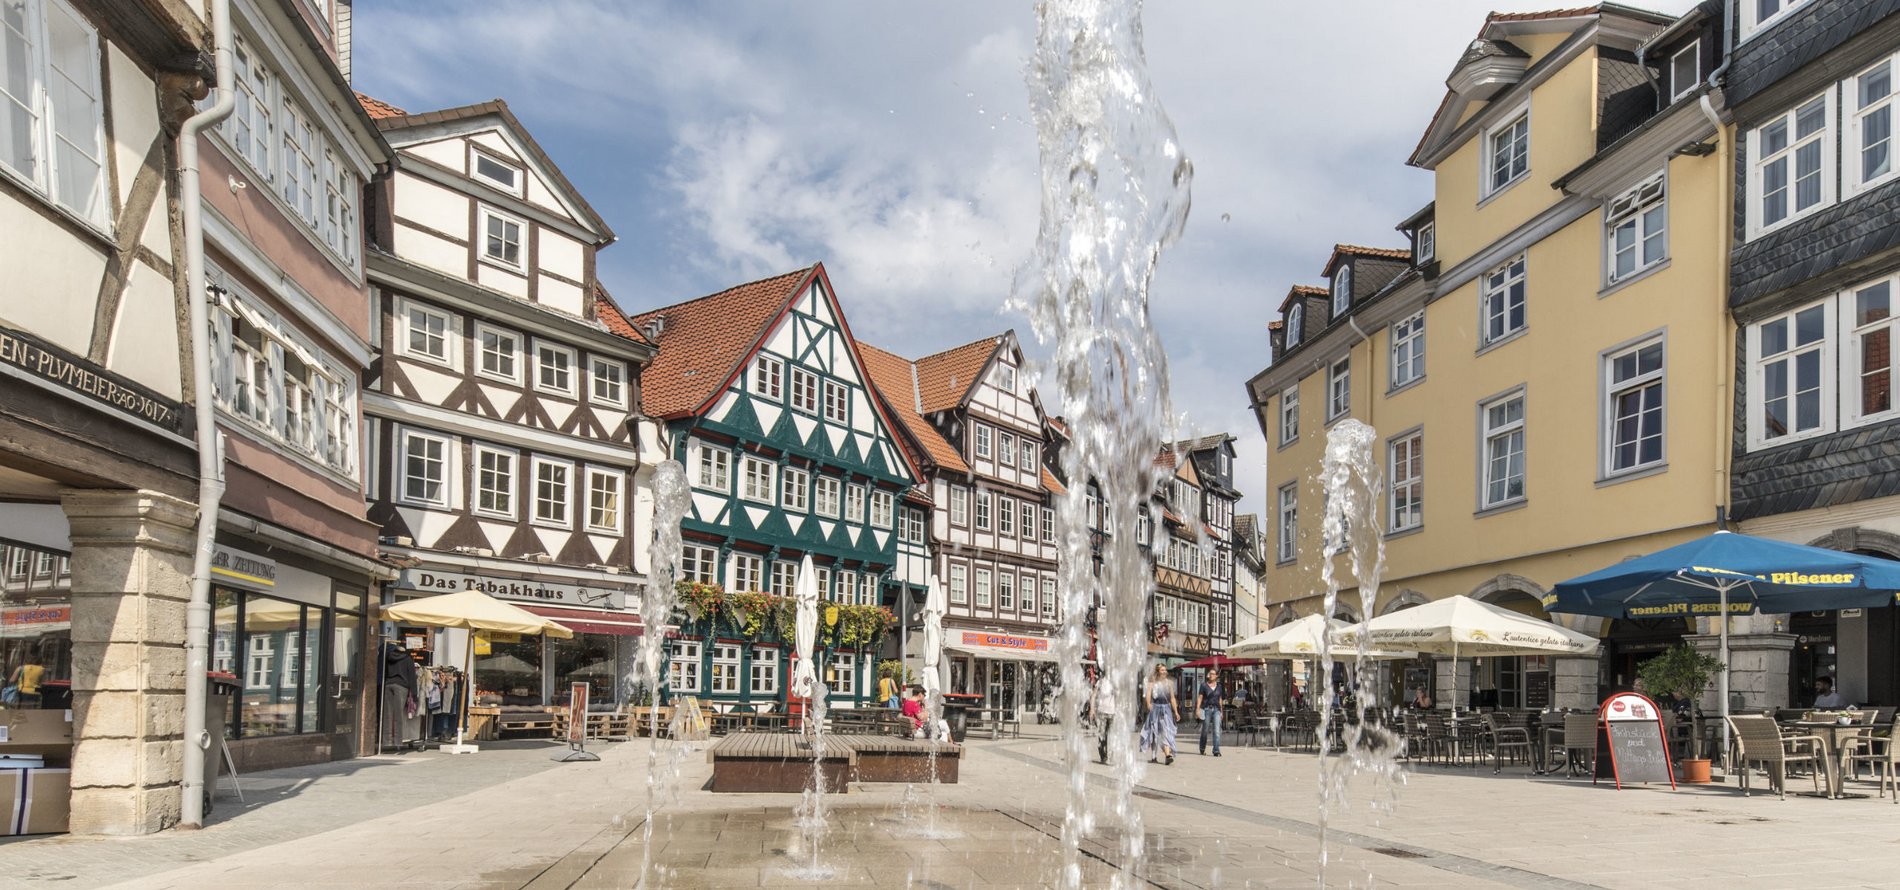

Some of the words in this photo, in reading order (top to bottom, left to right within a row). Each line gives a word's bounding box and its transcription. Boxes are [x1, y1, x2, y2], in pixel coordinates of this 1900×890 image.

[234, 556, 276, 579] ZEITUNG
[1771, 571, 1855, 585] Pilsener
[420, 573, 457, 589] Das
[463, 578, 564, 599] Tabakhaus
[986, 635, 999, 644] Cut
[1001, 637, 1007, 645] &
[1008, 637, 1027, 647] Style
[1539, 636, 1559, 646] gelato
[1560, 638, 1585, 648] italiano
